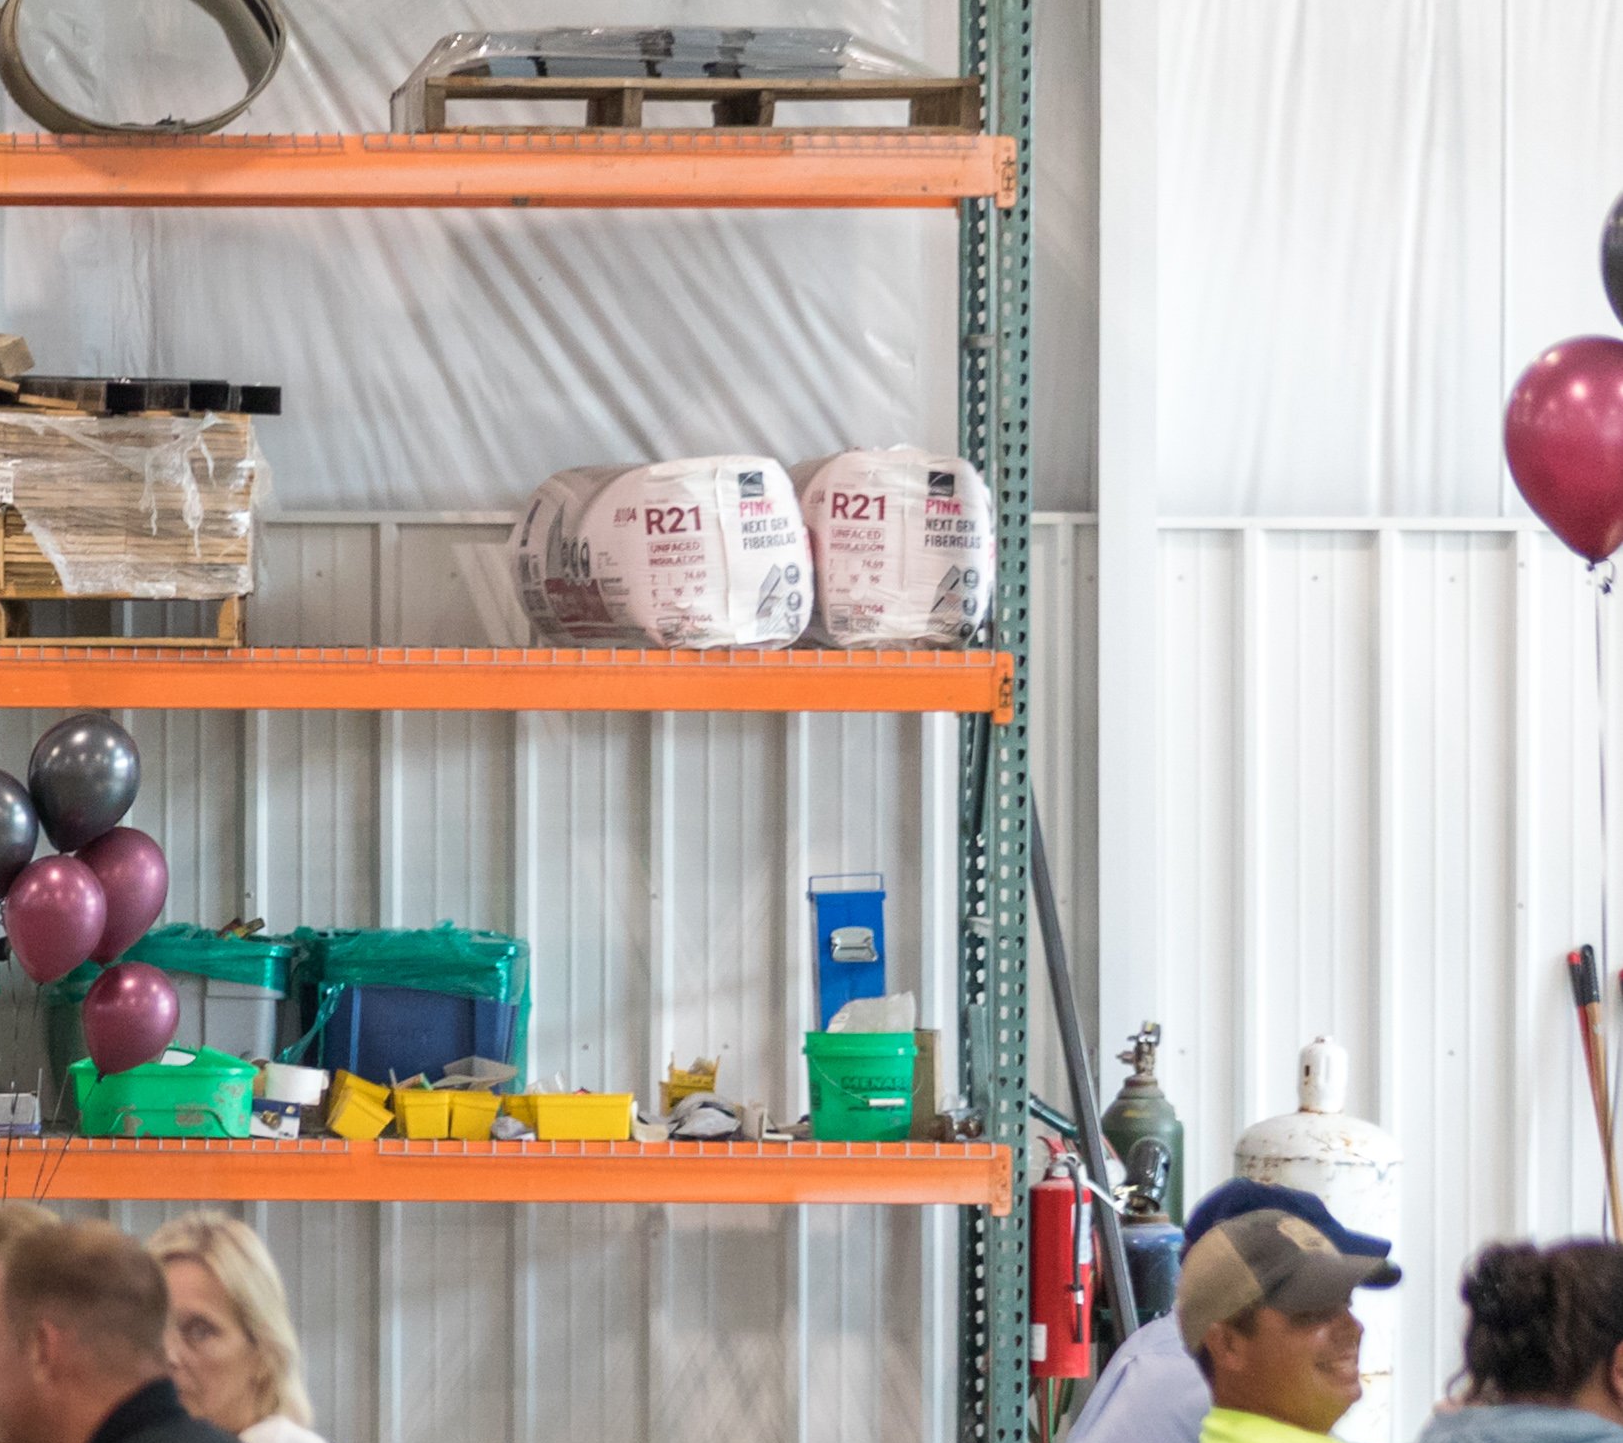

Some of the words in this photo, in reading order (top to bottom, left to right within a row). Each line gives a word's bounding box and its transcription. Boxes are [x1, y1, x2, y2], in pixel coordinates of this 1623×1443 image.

[831, 492, 886, 521] R21
[644, 505, 703, 536] R21
[741, 519, 768, 534] NEXT
[924, 518, 952, 532] NEXT
